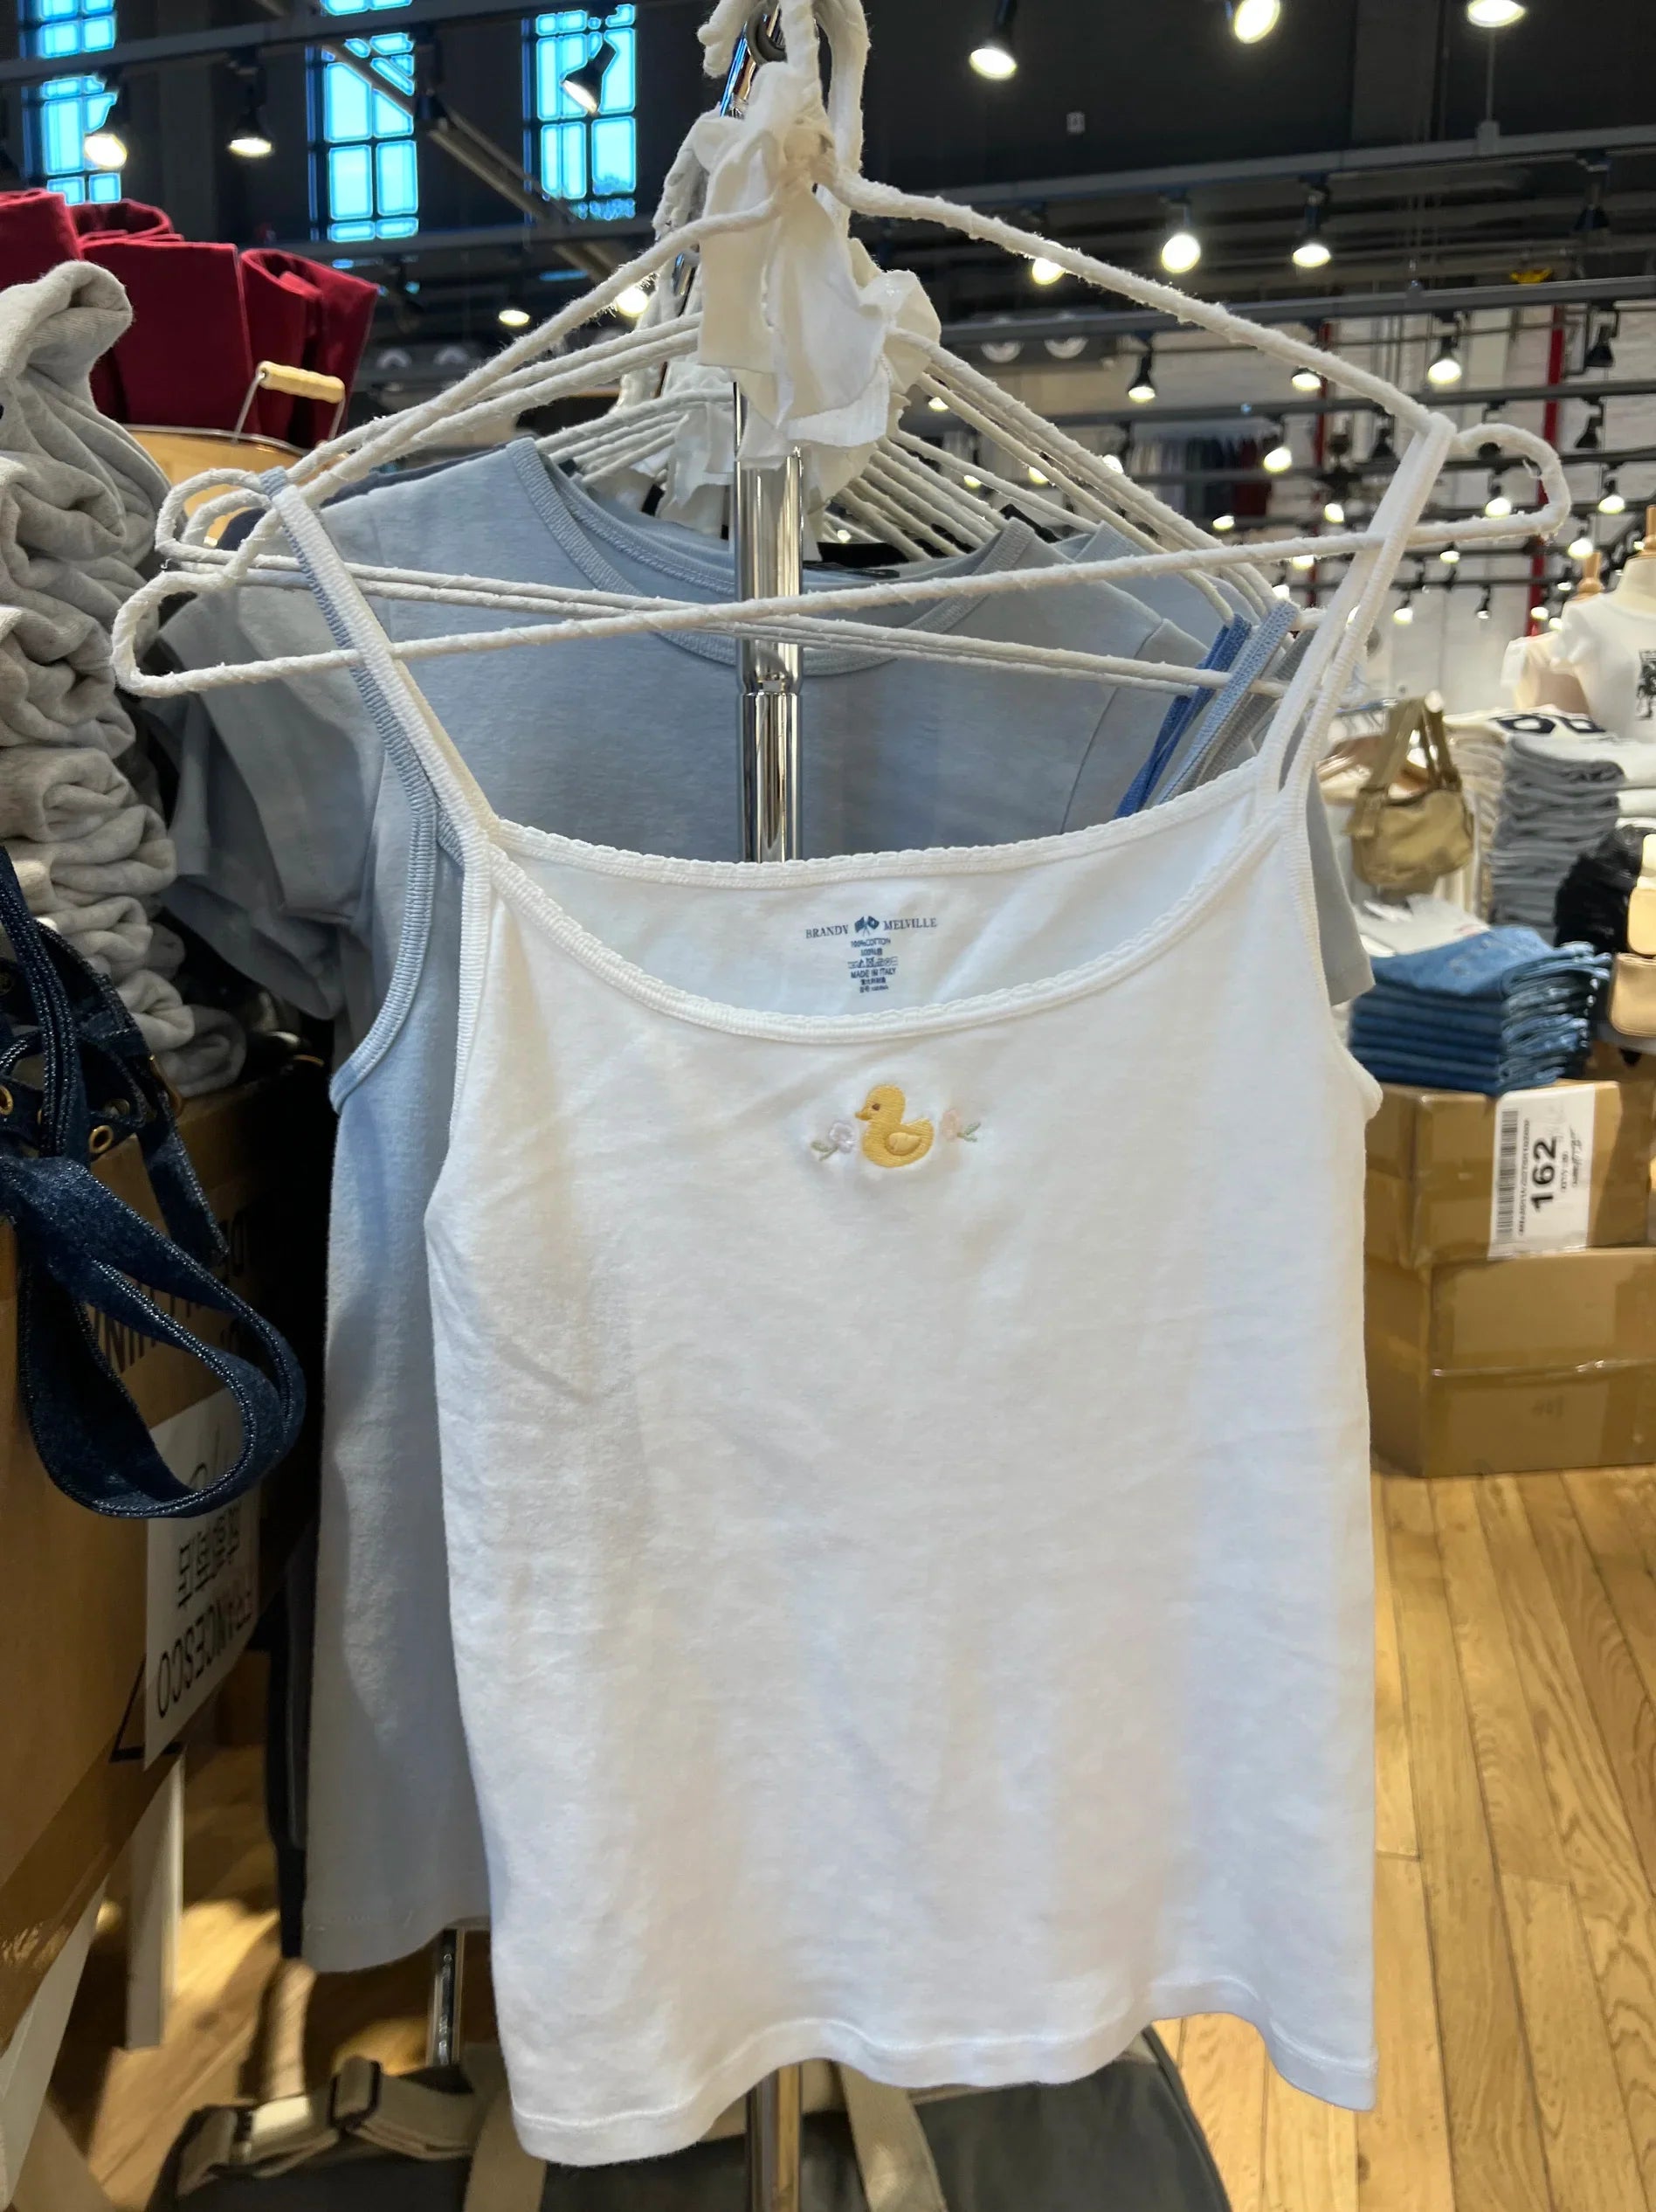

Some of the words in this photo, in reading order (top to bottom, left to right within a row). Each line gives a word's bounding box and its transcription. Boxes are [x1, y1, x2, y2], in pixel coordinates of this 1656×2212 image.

[805, 924, 849, 939] BRANDY
[883, 917, 937, 931] MELVILLE
[851, 969, 870, 978] MADE
[880, 967, 896, 976] ITALY
[1531, 1137, 1557, 1213] 162
